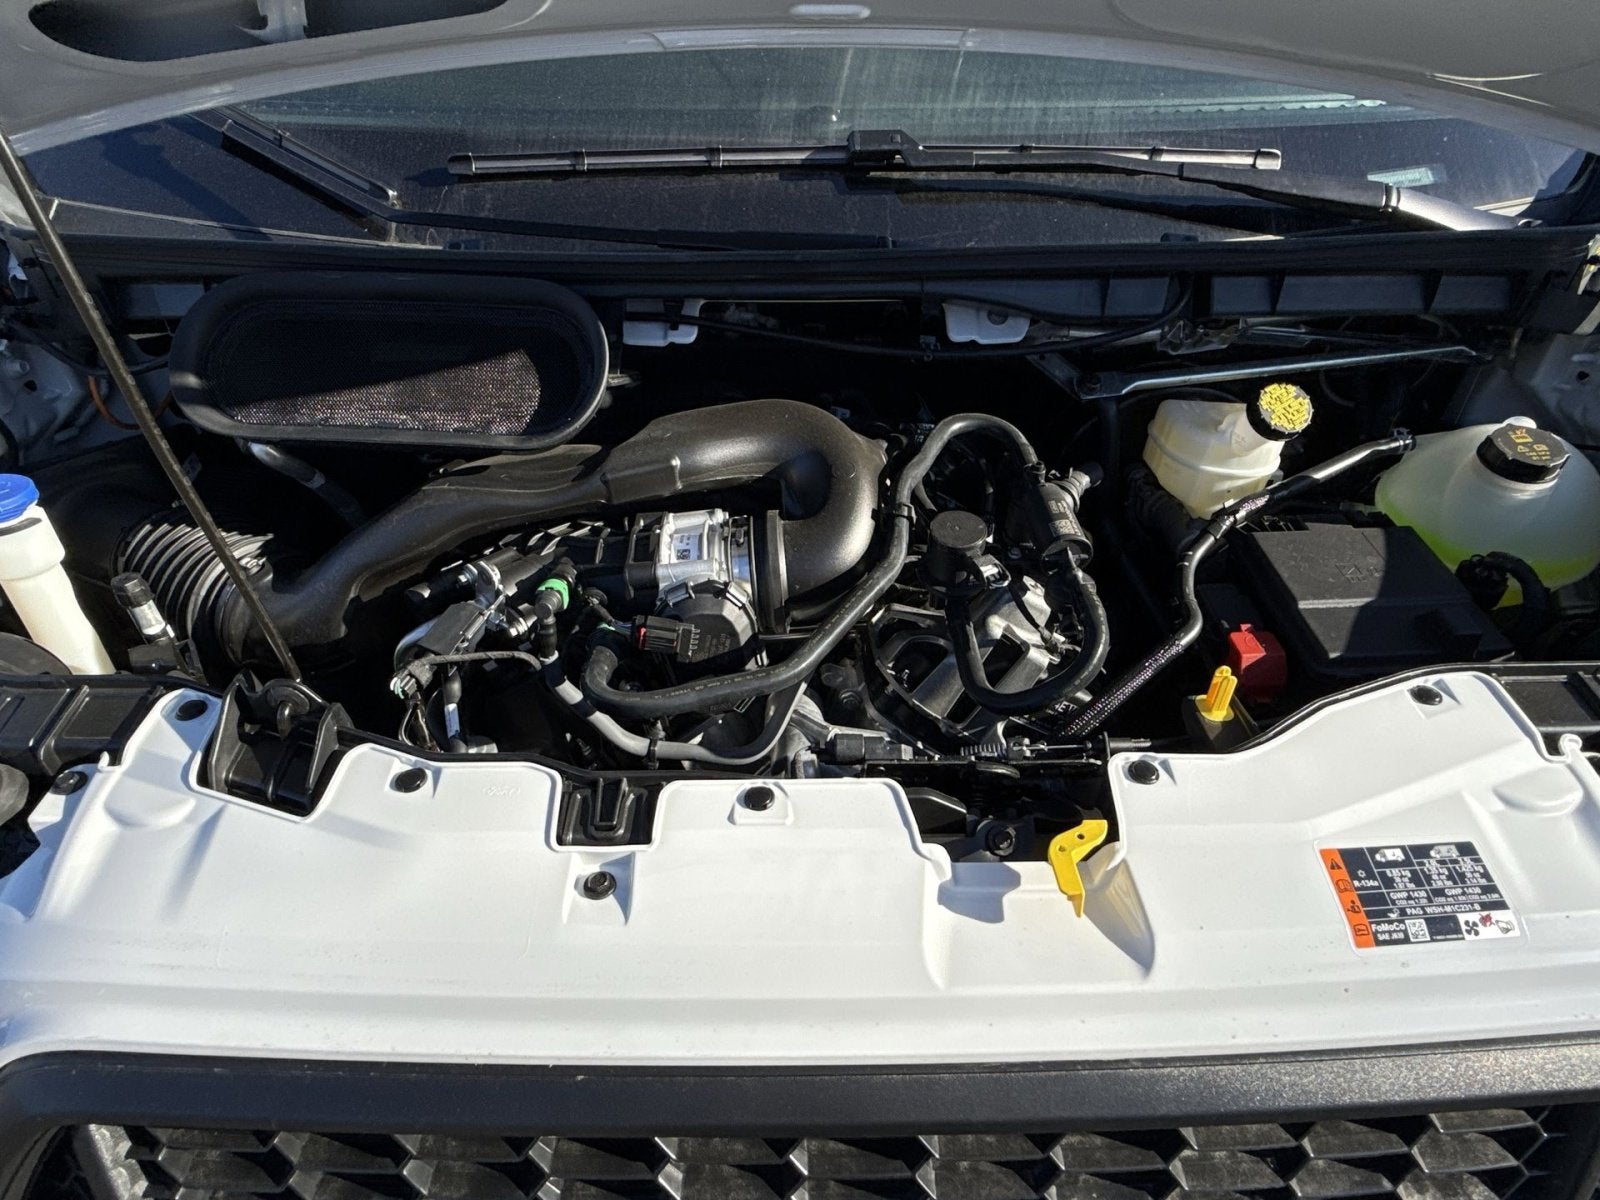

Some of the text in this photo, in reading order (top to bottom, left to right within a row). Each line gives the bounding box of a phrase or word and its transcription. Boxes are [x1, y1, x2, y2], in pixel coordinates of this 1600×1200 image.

[1401, 869, 1411, 878] kg
[1353, 879, 1379, 888] R-134a
[1390, 890, 1427, 900] GWP 1430
[1445, 887, 1481, 896] GWP 1430
[1406, 903, 1481, 916] PAG WSH-M1C231-B
[1371, 922, 1406, 932] FoMoCo
[1377, 932, 1391, 940] SAE
